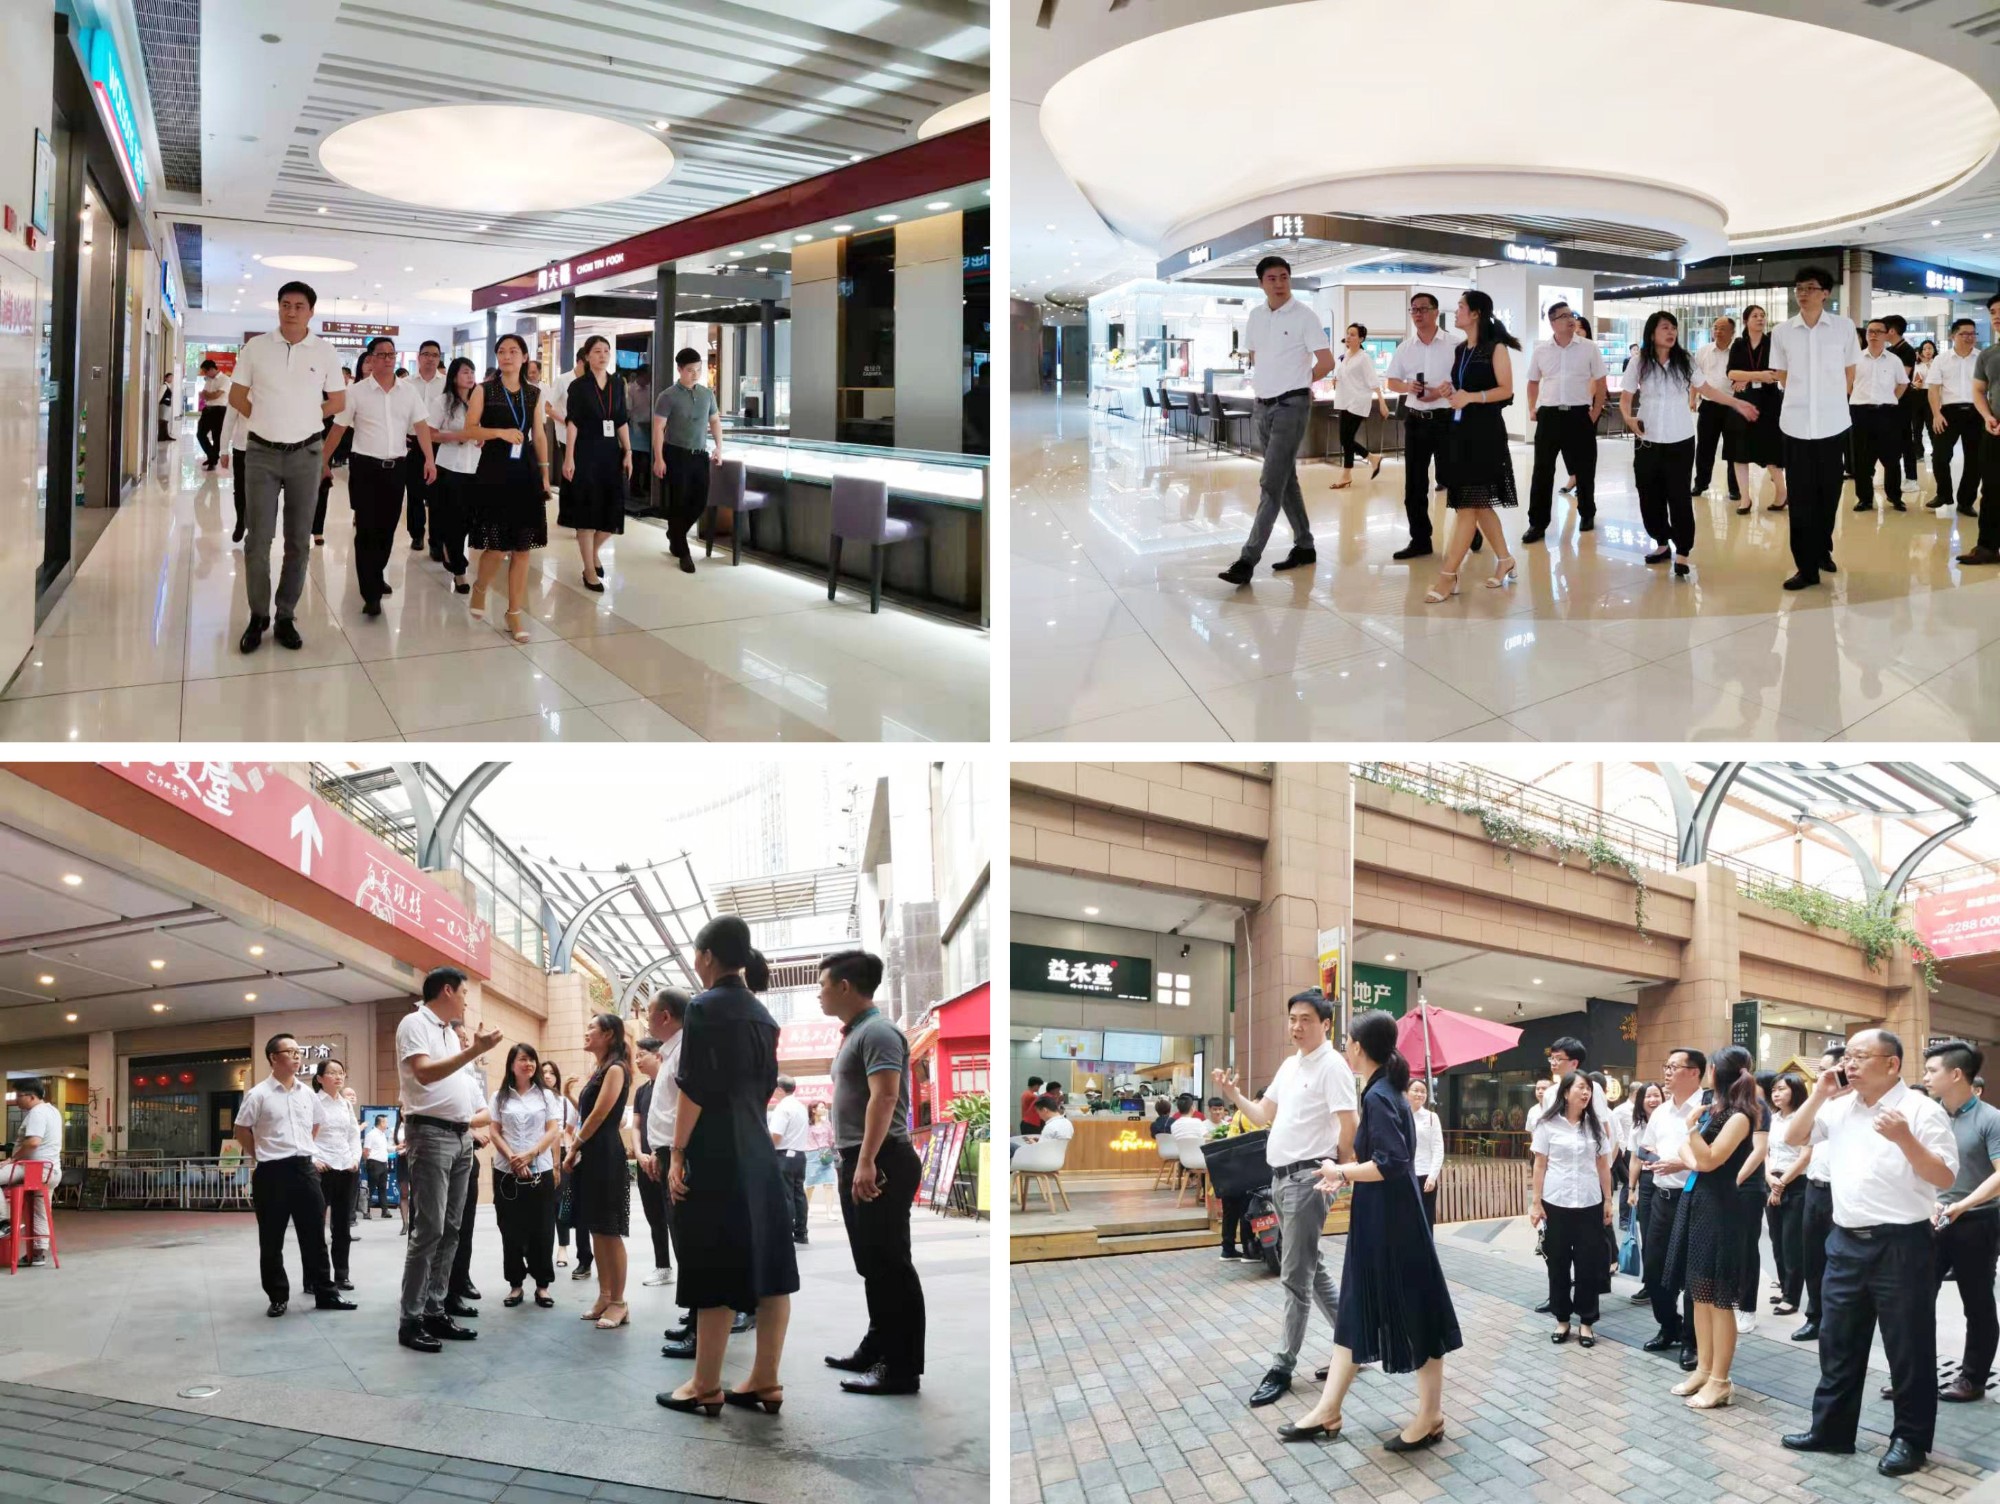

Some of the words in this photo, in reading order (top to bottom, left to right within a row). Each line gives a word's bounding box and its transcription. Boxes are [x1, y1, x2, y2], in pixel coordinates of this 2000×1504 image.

[1273, 216, 1304, 236] 周生生
[1047, 958, 1114, 985] 益禾堂
[1353, 980, 1392, 1004] 地产
